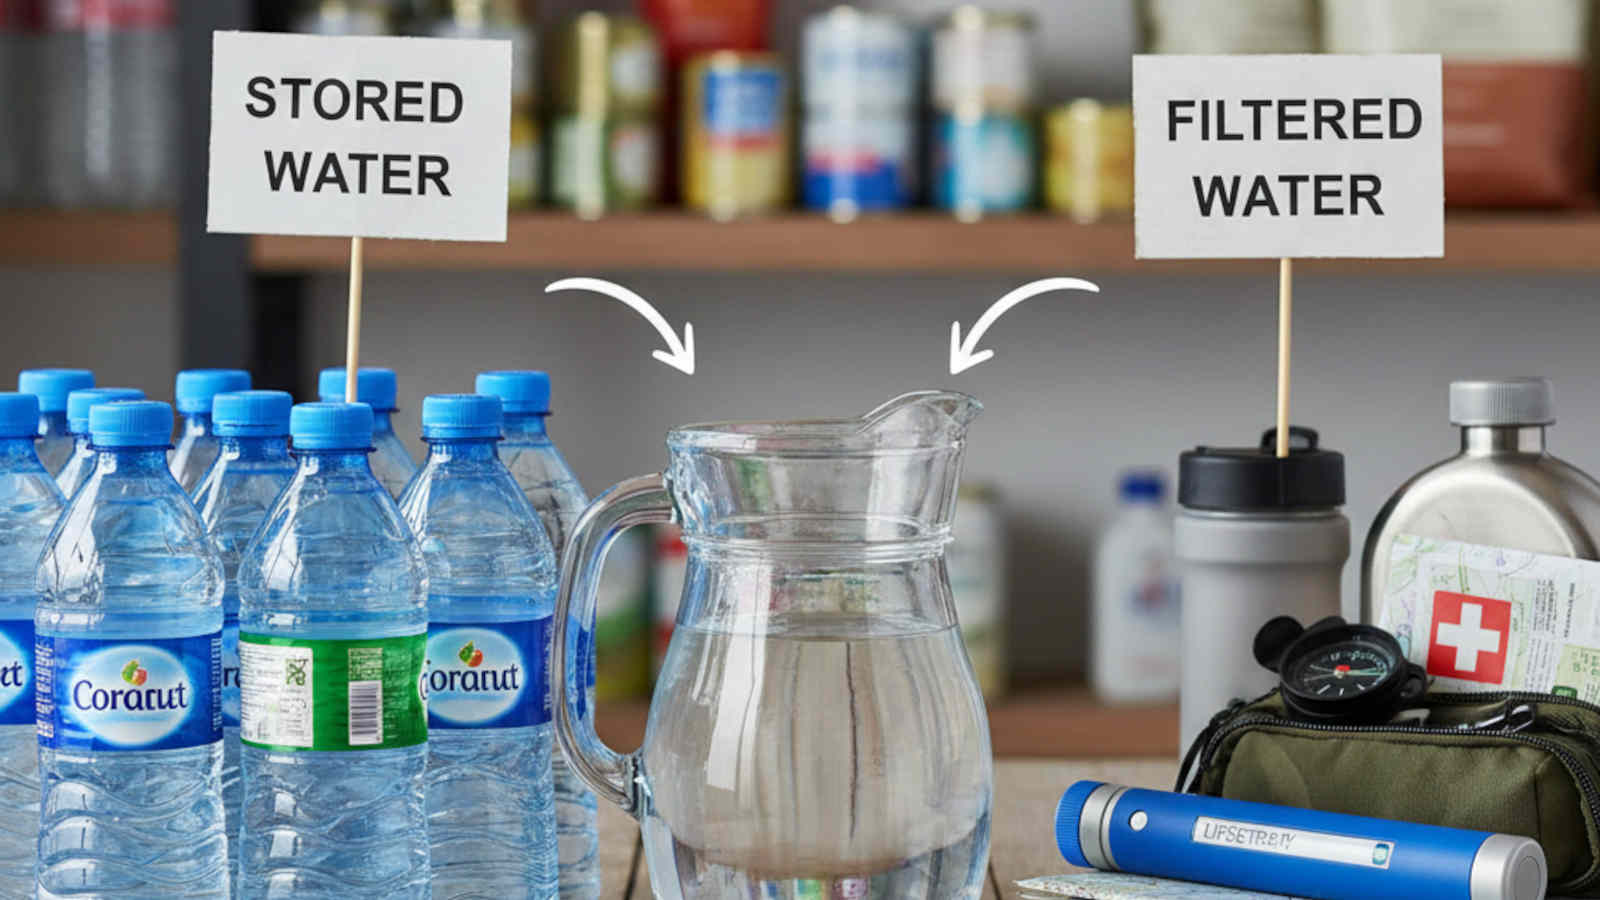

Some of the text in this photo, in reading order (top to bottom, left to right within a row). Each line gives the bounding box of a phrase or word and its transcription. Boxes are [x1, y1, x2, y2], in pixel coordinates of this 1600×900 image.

[246, 77, 463, 122] STORED
[1168, 98, 1422, 141] FILTERED
[264, 151, 451, 196] WATER
[1193, 174, 1385, 217] WATER
